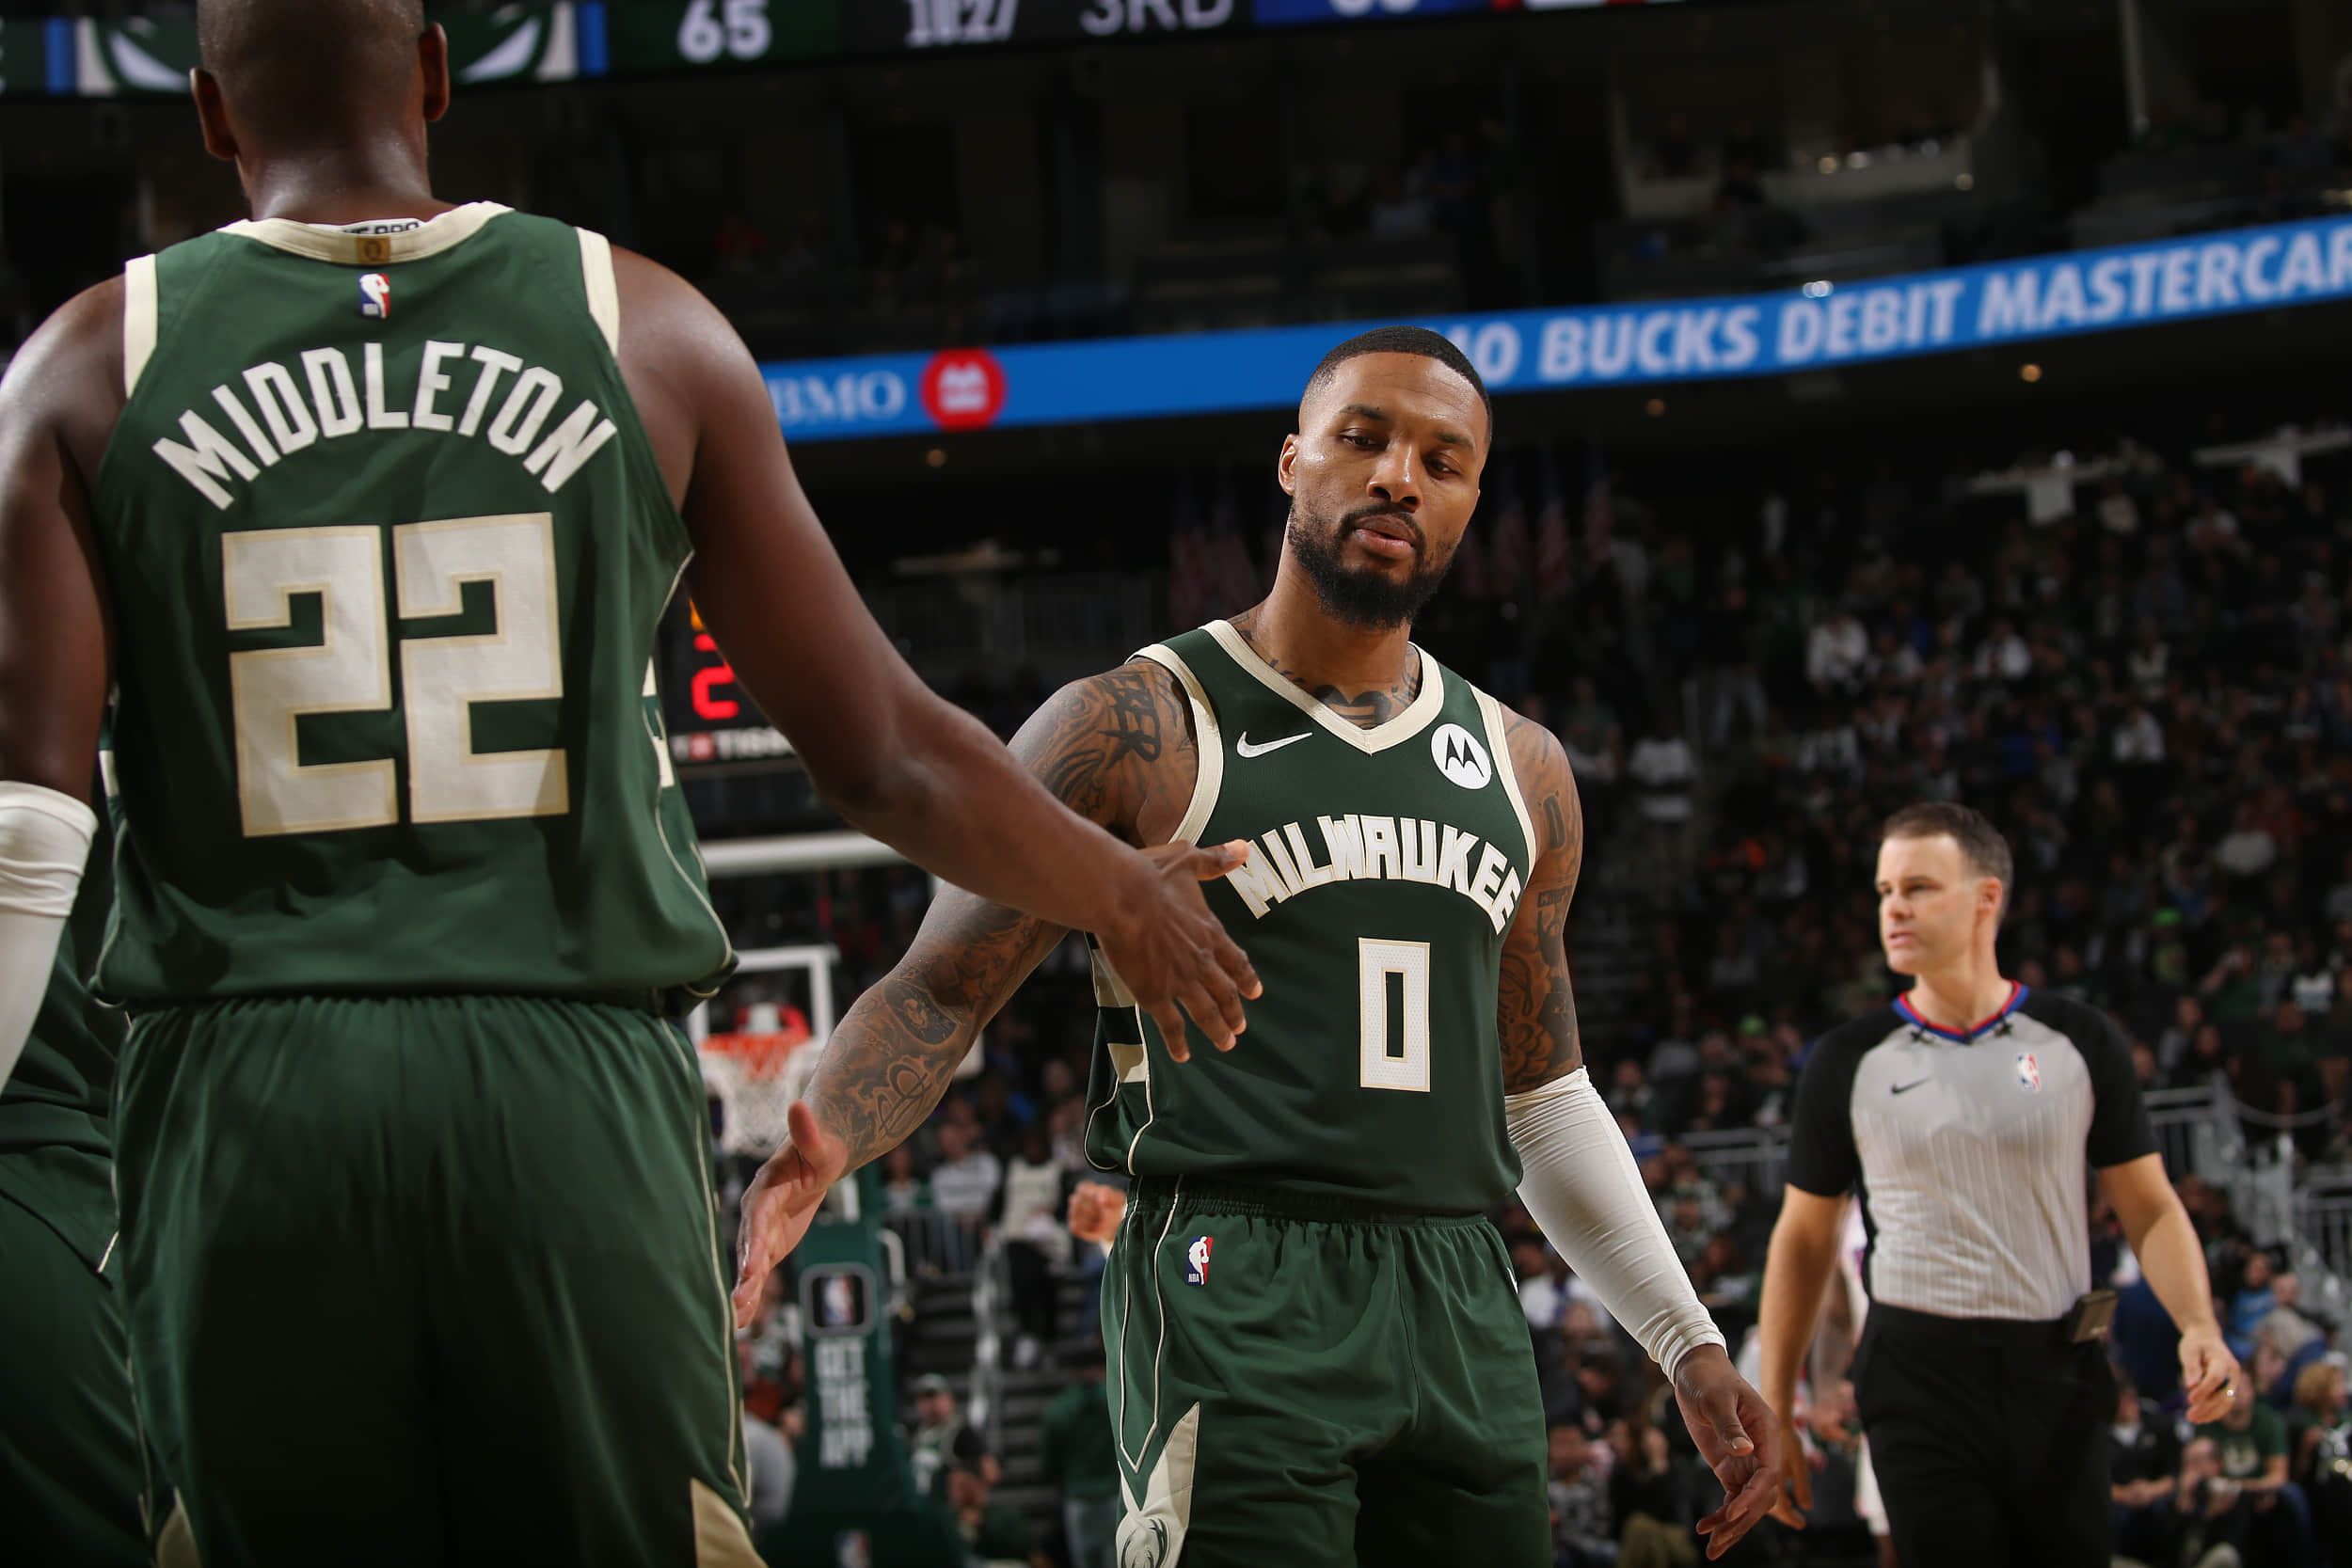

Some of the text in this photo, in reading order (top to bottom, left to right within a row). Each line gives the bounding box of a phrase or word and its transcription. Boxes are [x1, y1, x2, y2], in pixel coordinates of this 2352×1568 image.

[677, 0, 771, 63] 65
[1537, 305, 1760, 384] BUCKS
[1777, 278, 1964, 365] DEBIT
[152, 340, 618, 511] MIDDLETON
[221, 512, 570, 838] 22
[1225, 814, 1522, 936] MILWAUKEE
[1358, 937, 1431, 1093] 0
